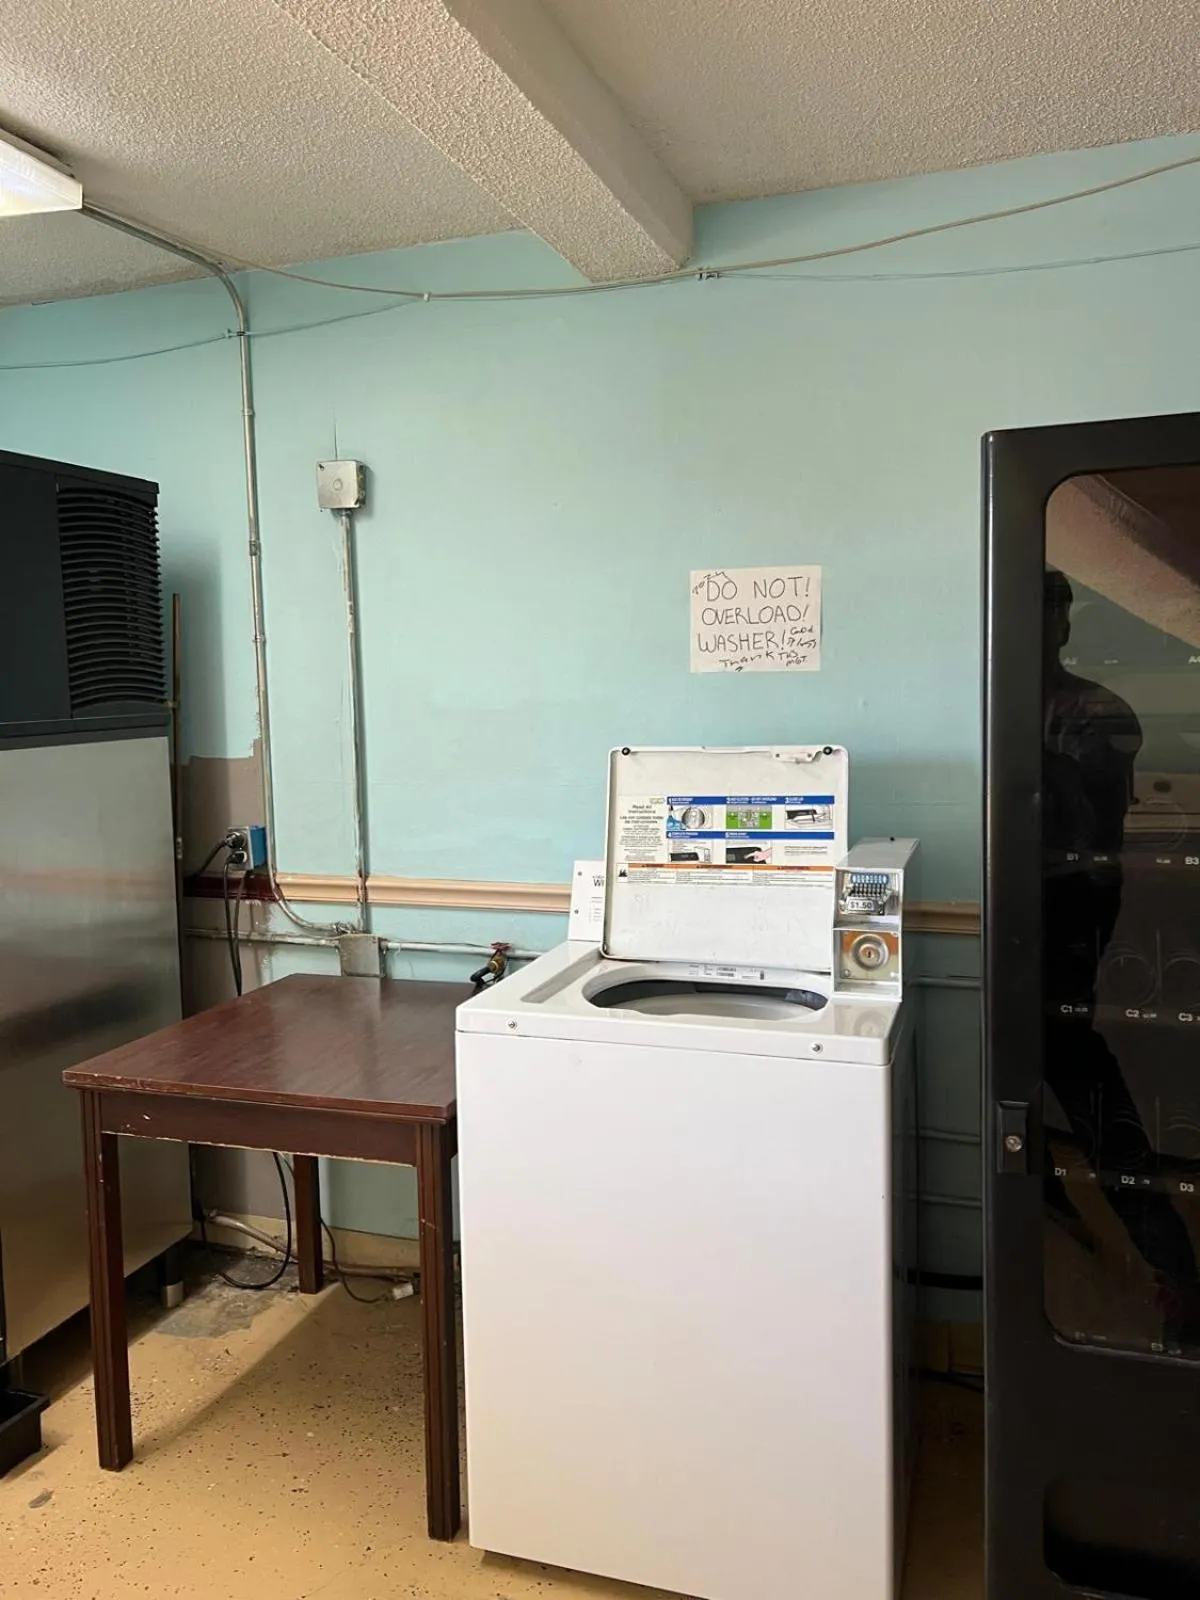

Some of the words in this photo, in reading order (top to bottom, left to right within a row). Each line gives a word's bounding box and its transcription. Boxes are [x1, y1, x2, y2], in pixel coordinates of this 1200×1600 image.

[706, 580, 738, 602] DO
[753, 576, 811, 599] NOT!
[701, 604, 810, 626] OVERLOAD!
[697, 629, 786, 653] WASHER!
[1184, 855, 1200, 866] B3
[849, 901, 873, 910] $1.50
[1059, 1004, 1073, 1014] C1
[1125, 1008, 1140, 1018] C2
[1178, 1012, 1194, 1022] C3
[1054, 1167, 1067, 1177] D1
[1120, 1175, 1136, 1185] D2
[1179, 1182, 1194, 1193] D3
